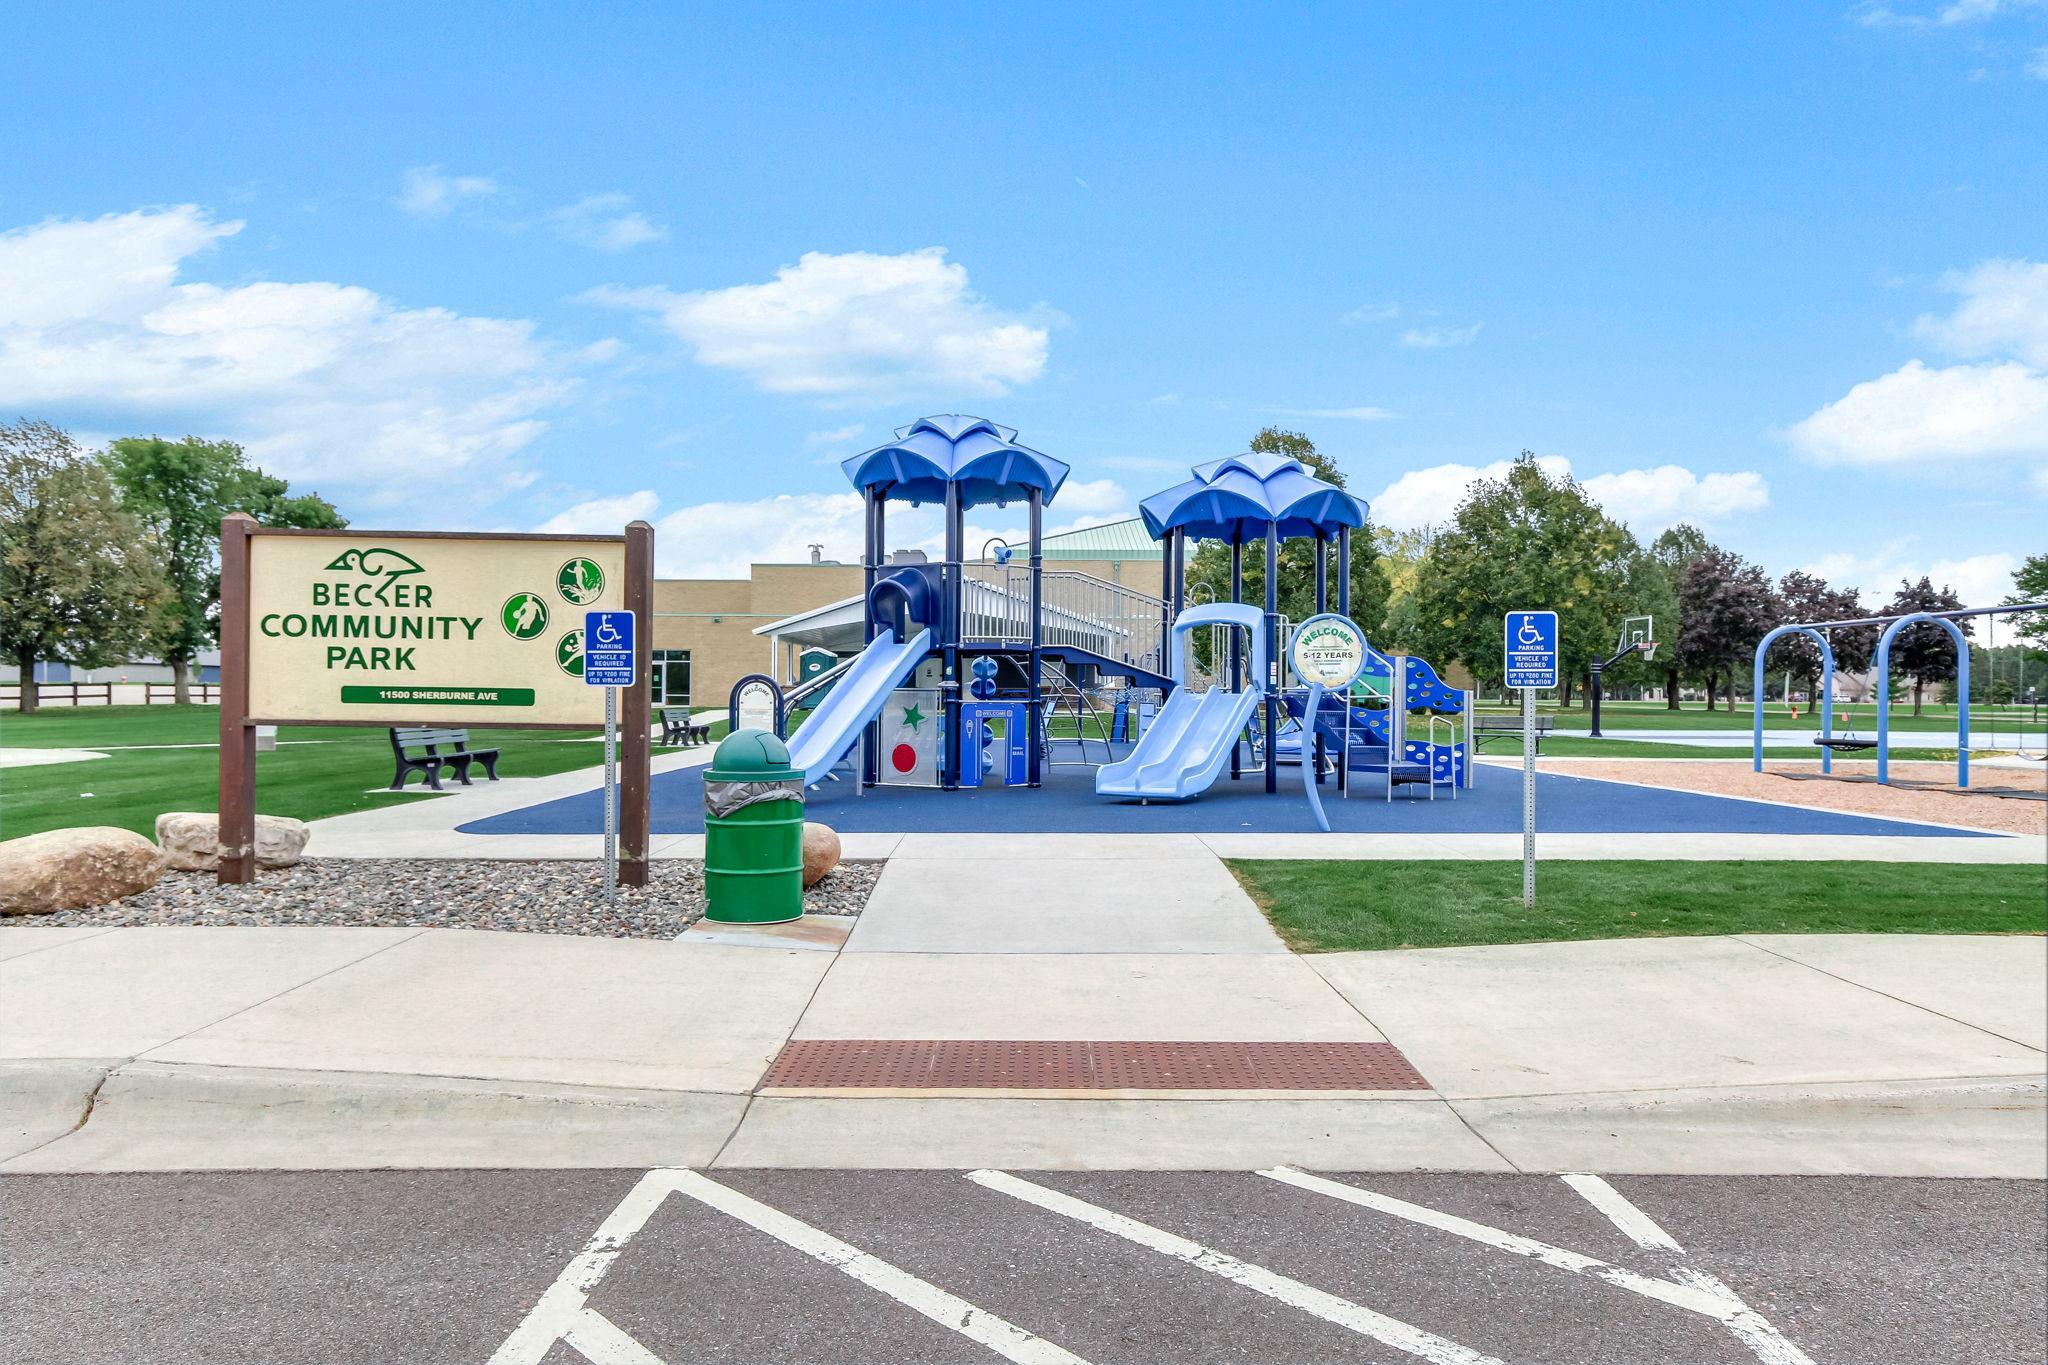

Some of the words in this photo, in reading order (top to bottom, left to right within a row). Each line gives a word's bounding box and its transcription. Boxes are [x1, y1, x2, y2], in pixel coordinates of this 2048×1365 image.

[260, 613, 484, 640] COMMUNITY
[1302, 628, 1354, 646] WELCOME
[327, 646, 417, 670] PARK
[1324, 651, 1353, 659] YEARS
[379, 691, 410, 699] 11500
[412, 691, 476, 700] SHERBURNE
[477, 692, 498, 700] AVE
[743, 687, 770, 696] WELCOME
